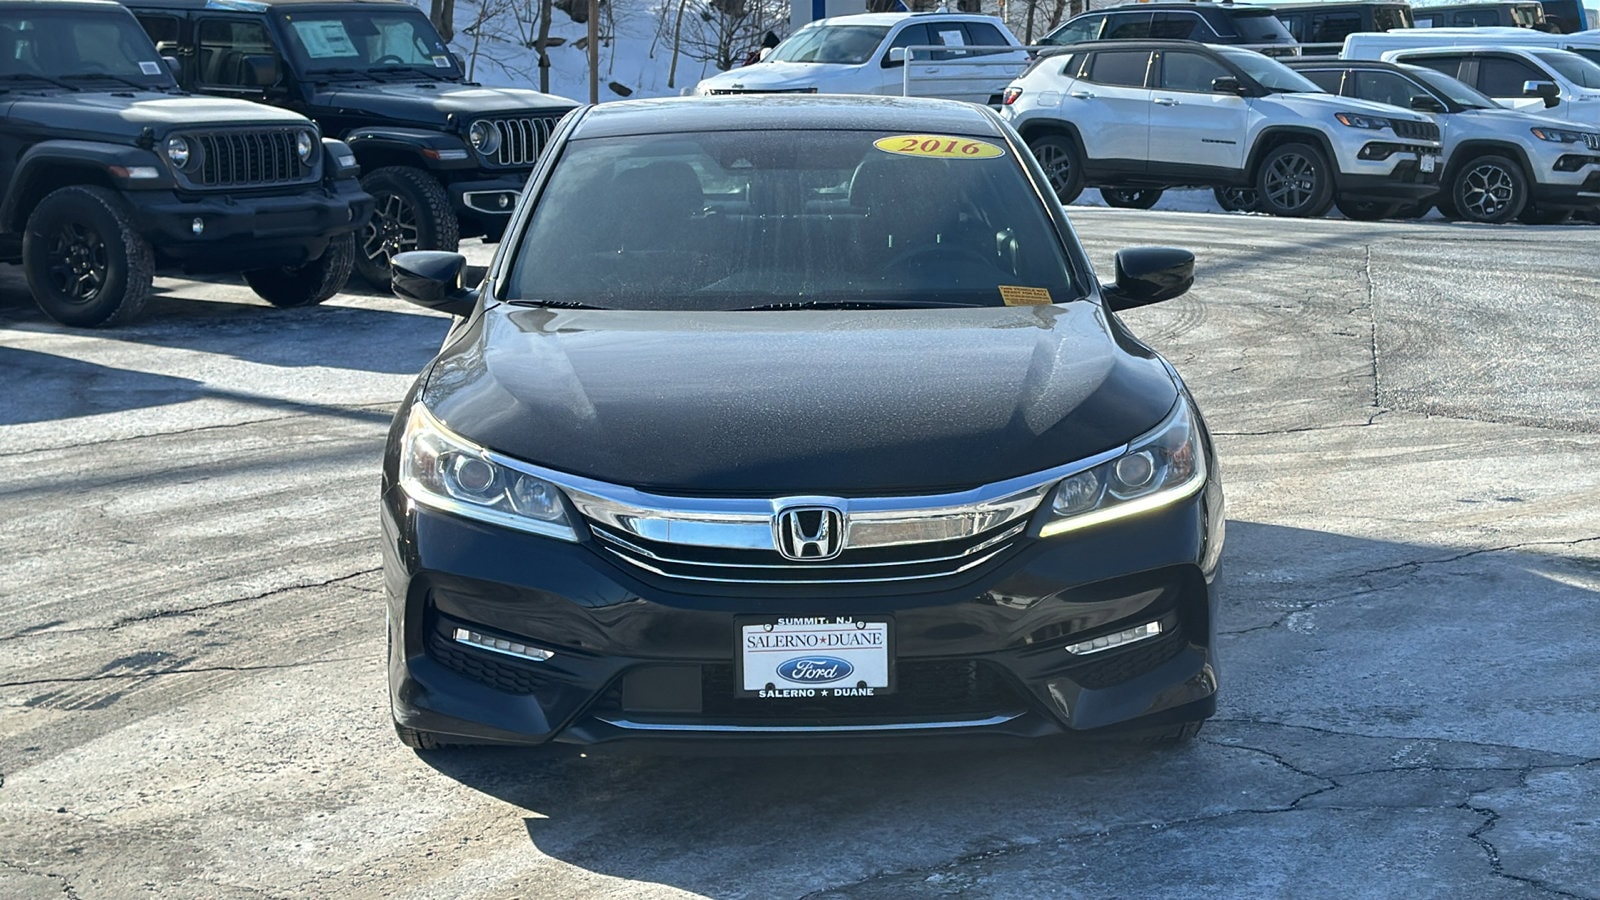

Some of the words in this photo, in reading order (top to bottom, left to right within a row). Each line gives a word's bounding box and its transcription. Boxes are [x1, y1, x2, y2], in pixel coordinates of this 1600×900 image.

[898, 139, 980, 155] 2016
[836, 616, 853, 624] NJ
[747, 634, 818, 649] SALERNO
[828, 632, 883, 647] DUANE
[792, 659, 838, 679] Ford
[759, 689, 815, 698] SALERNO
[834, 687, 874, 696] DUANE
